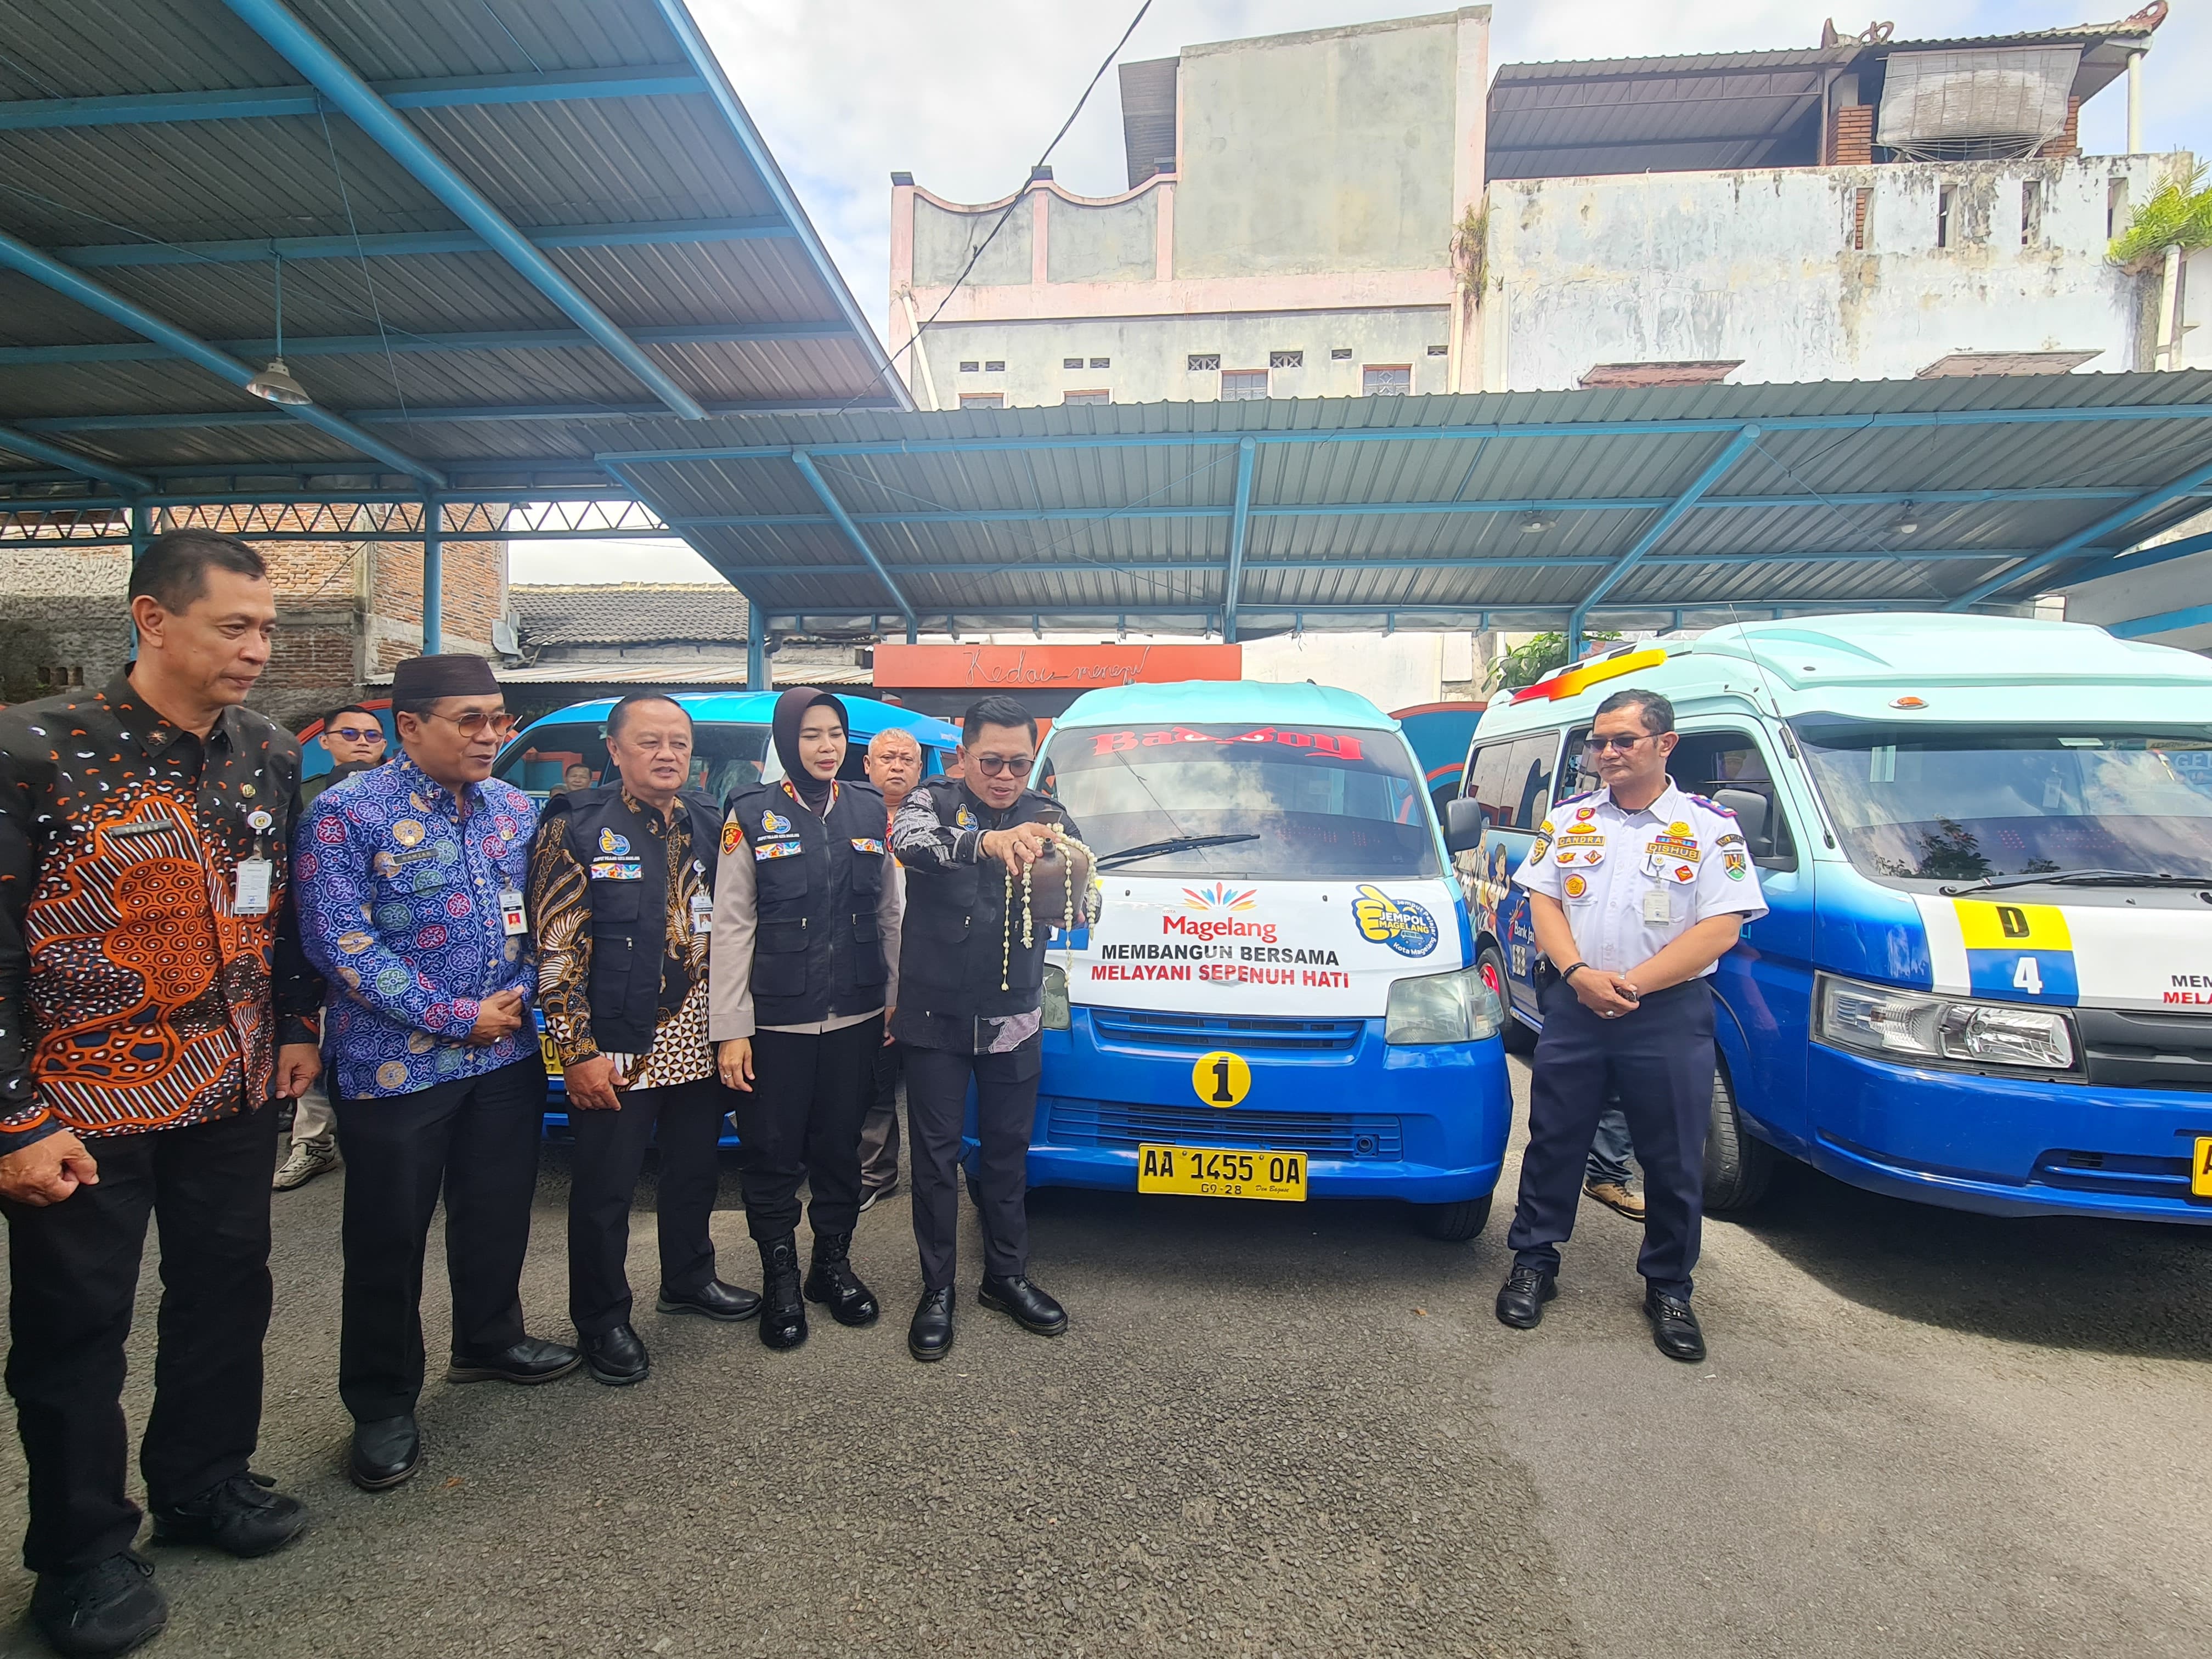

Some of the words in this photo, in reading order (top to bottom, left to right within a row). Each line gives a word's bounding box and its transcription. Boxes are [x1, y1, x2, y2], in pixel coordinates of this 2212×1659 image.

[1649, 844, 1697, 859] DISHUB
[1163, 915, 1278, 944] Magelang
[1379, 911, 1426, 927] JEMPOL
[1379, 920, 1430, 934] MAGELANG
[1396, 900, 1424, 912] Jemput
[1423, 911, 1436, 936] Pelajar
[1514, 920, 1527, 940] Bank
[1996, 906, 2030, 938] D
[1101, 944, 1233, 960] MEMBANGUN
[1240, 946, 1340, 966] BERSAMA
[1393, 942, 1410, 955] Kota
[1410, 936, 1437, 956] Magelang
[1090, 965, 1192, 981] MELAYANI
[1198, 964, 1295, 985] SEPENUH
[1302, 970, 1350, 989] HATI
[2012, 957, 2043, 995] 4
[1212, 1056, 1233, 1102] 1
[1143, 1150, 1174, 1177] AA
[1190, 1153, 1253, 1181] 1455
